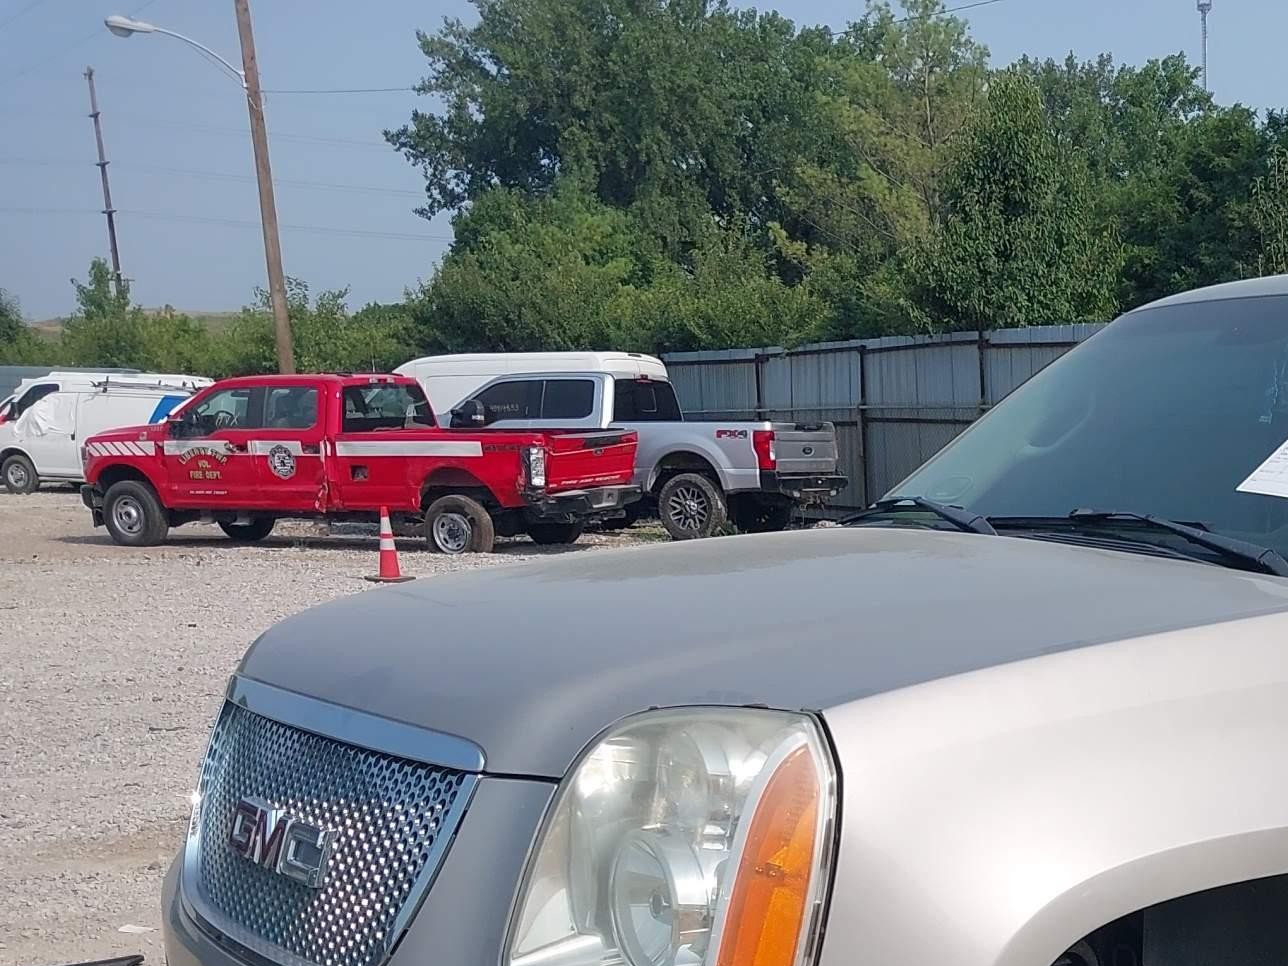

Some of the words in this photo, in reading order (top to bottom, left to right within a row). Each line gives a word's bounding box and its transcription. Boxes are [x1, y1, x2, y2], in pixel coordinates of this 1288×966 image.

[716, 430, 748, 439] FX4
[190, 470, 203, 479] FIRE
[229, 797, 337, 888] GMC
